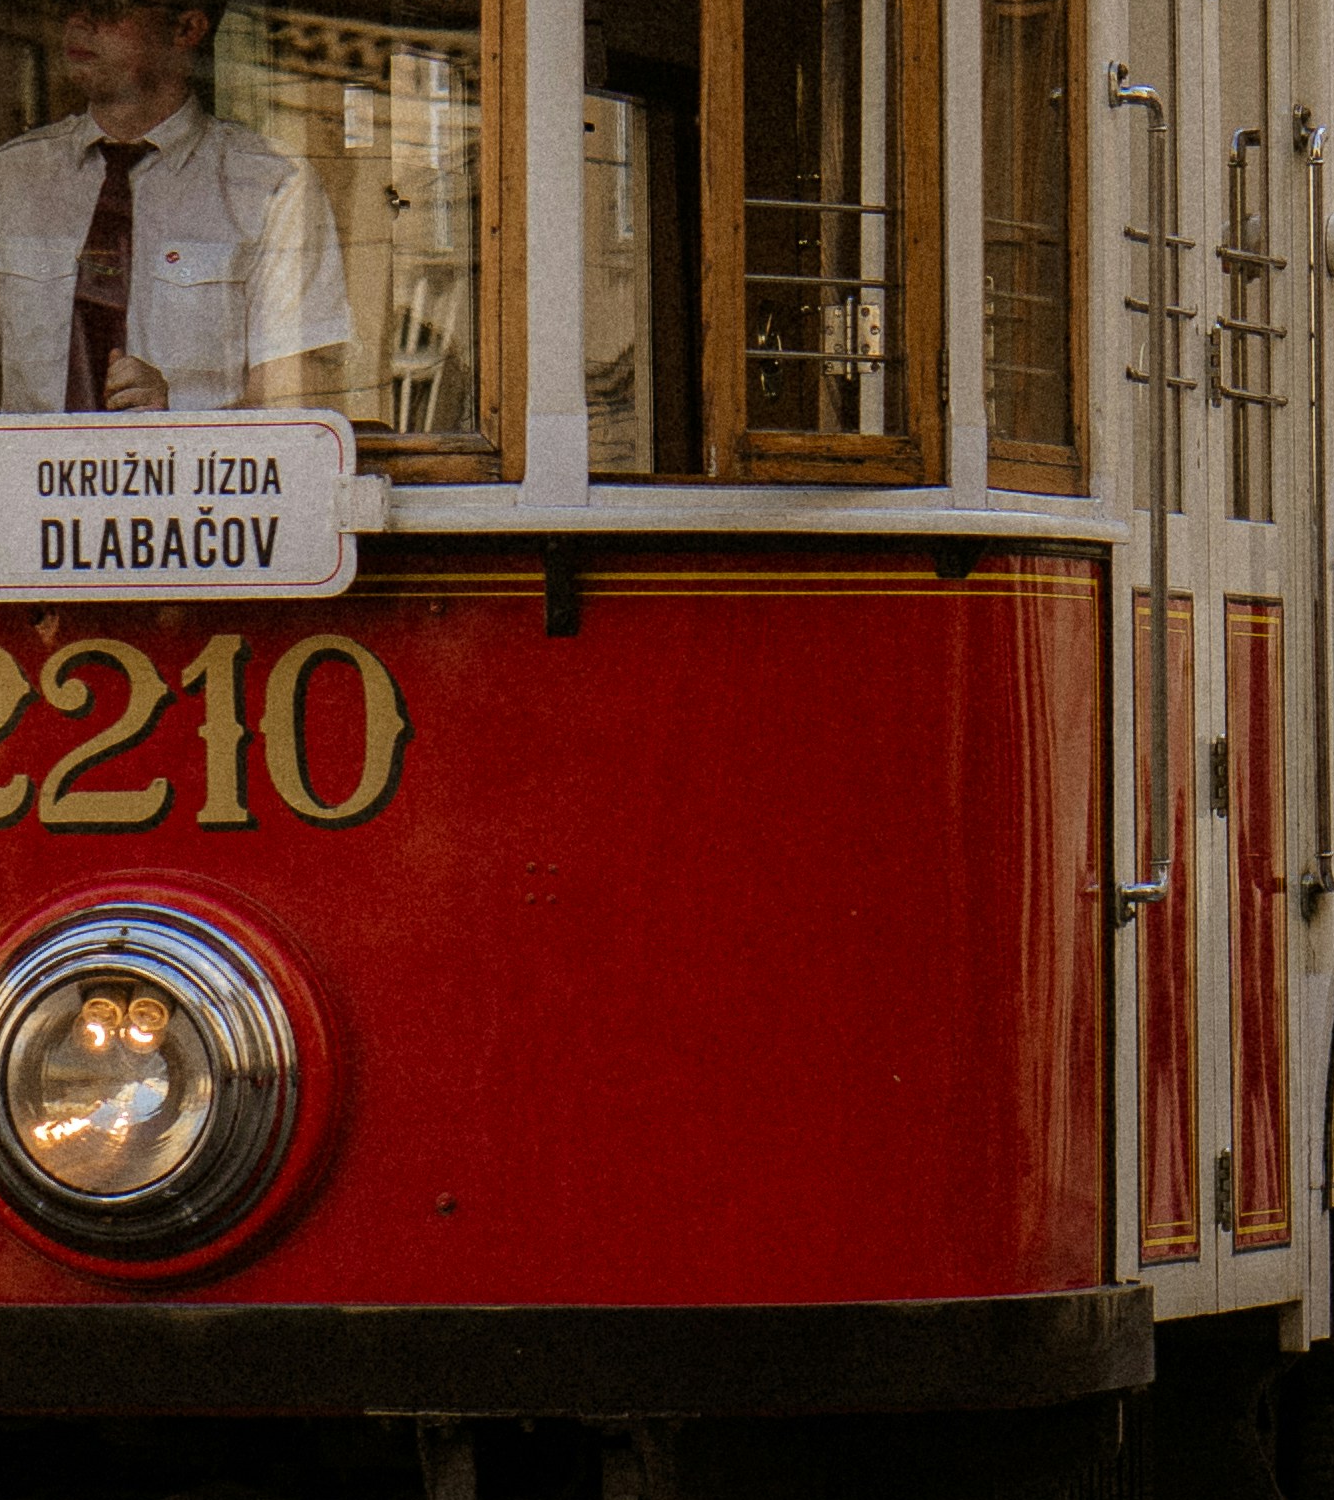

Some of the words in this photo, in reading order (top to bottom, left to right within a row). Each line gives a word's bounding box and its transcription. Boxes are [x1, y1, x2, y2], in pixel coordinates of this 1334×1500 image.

[37, 446, 175, 498] OKRUŽNÍ
[193, 449, 282, 496] JÍZDA
[40, 506, 279, 571] DLABAČOV
